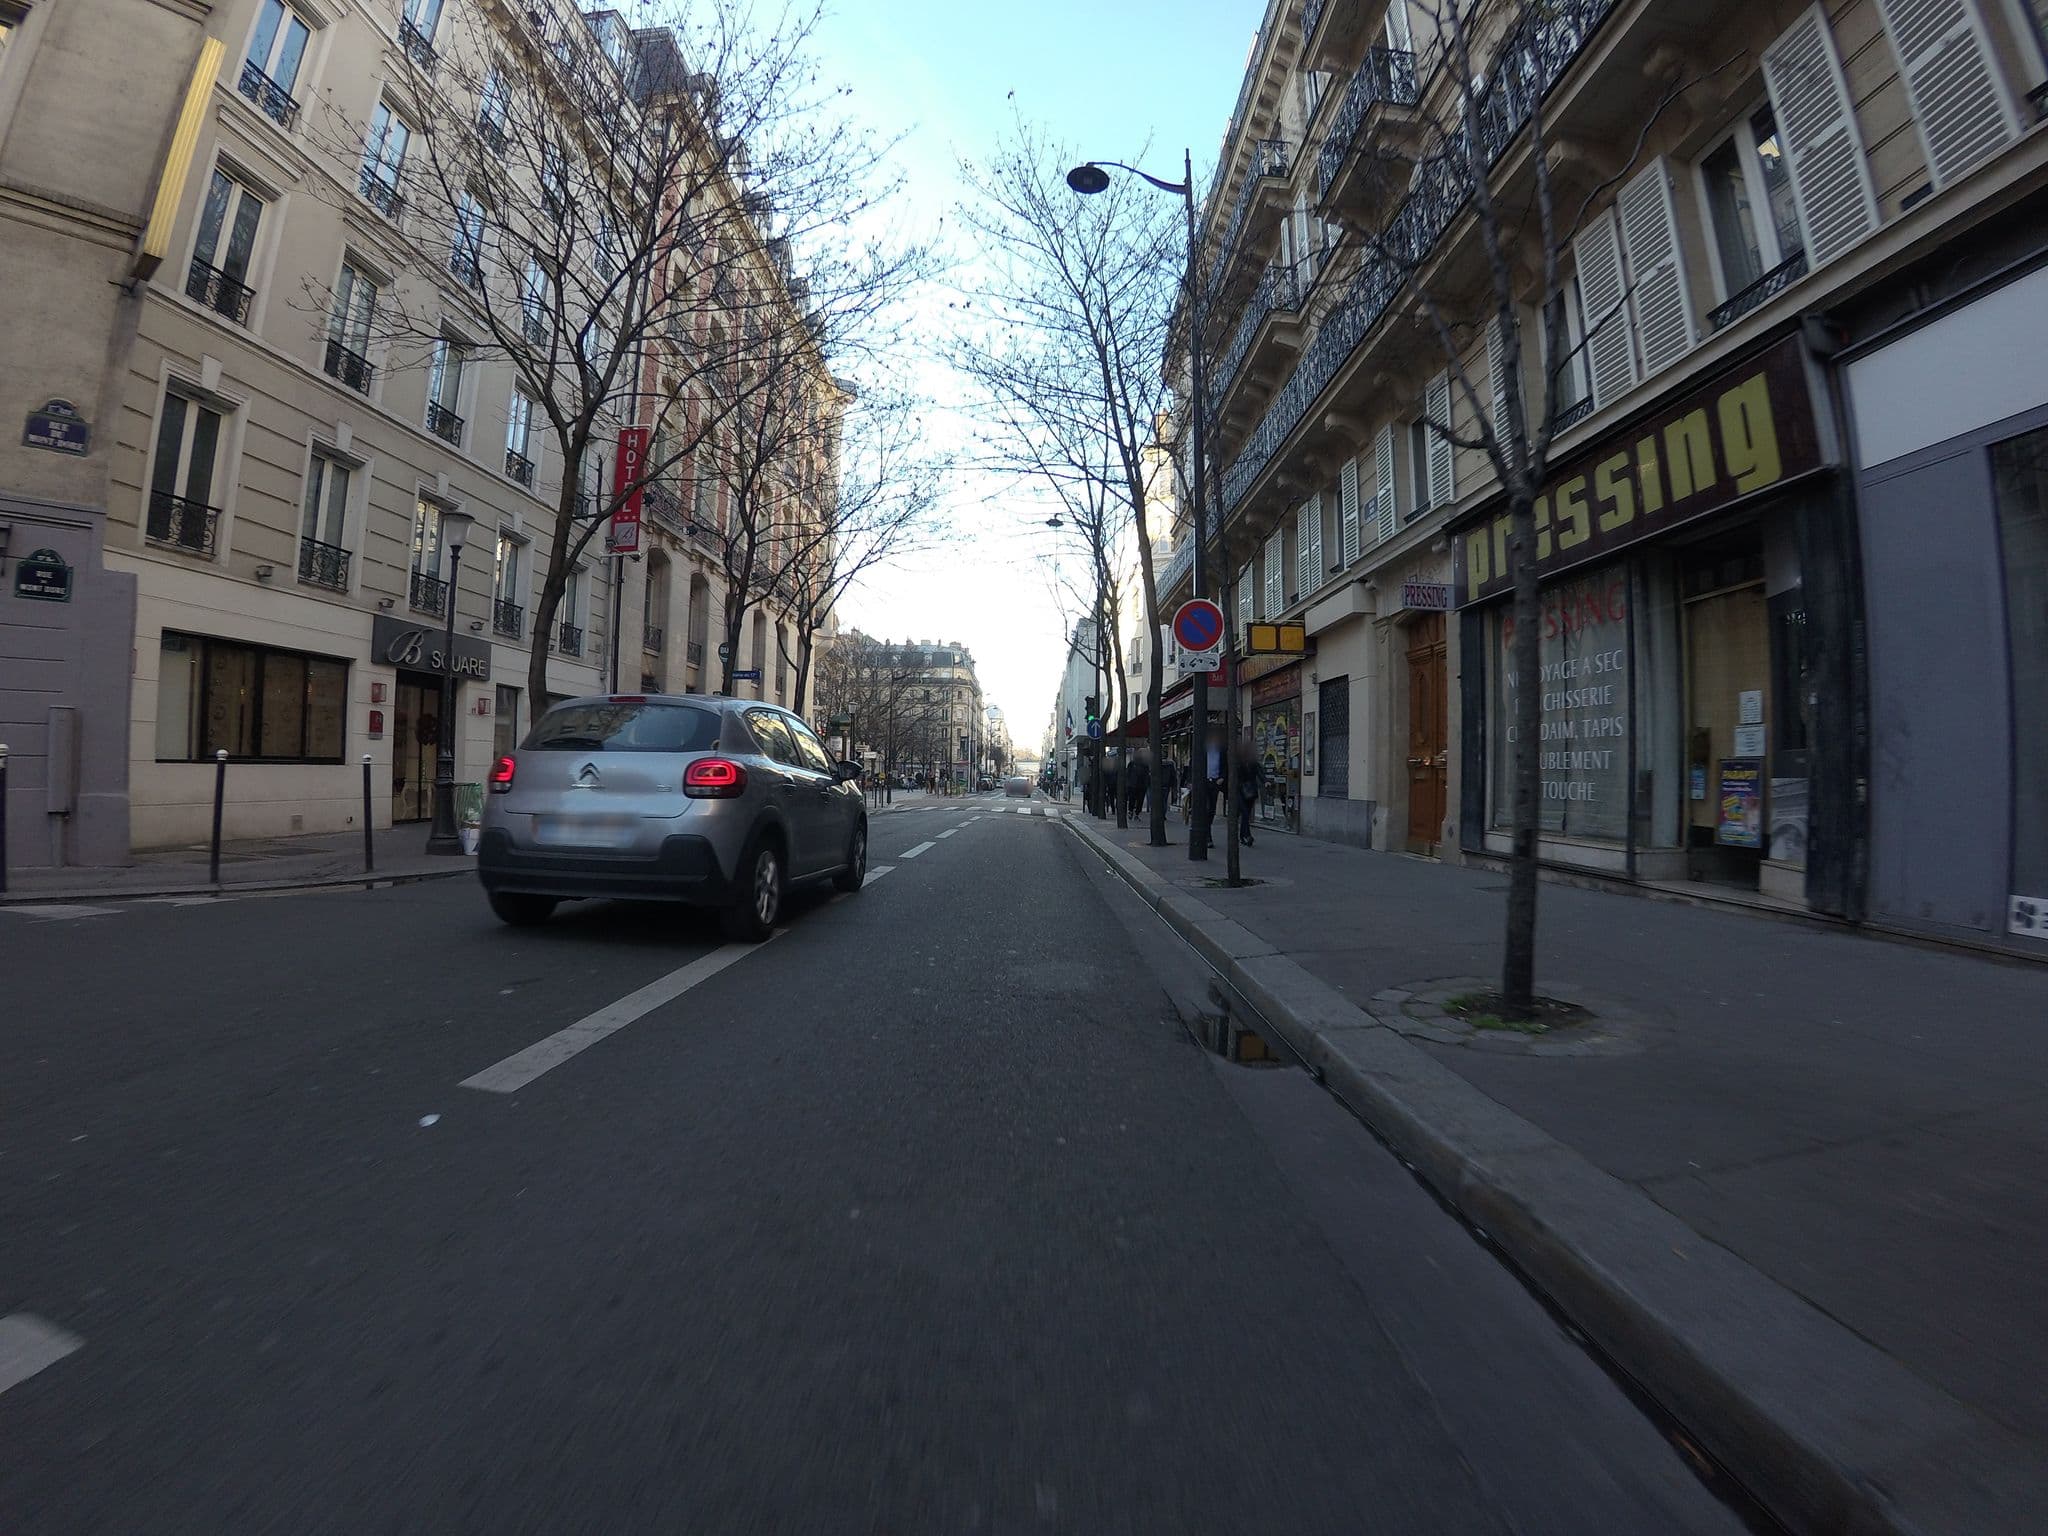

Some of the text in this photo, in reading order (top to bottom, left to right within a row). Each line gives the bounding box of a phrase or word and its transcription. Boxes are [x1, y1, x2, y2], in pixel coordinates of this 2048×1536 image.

[1466, 372, 1784, 601] pressing
[1404, 585, 1448, 608] PRESSING
[1503, 581, 1626, 649] PSSING
[387, 629, 433, 665] B
[1595, 649, 1623, 674] SEC
[1582, 716, 1624, 738] TAPIS
[1539, 750, 1613, 771] UBLEMENT
[1541, 780, 1597, 802] TOUCHE
